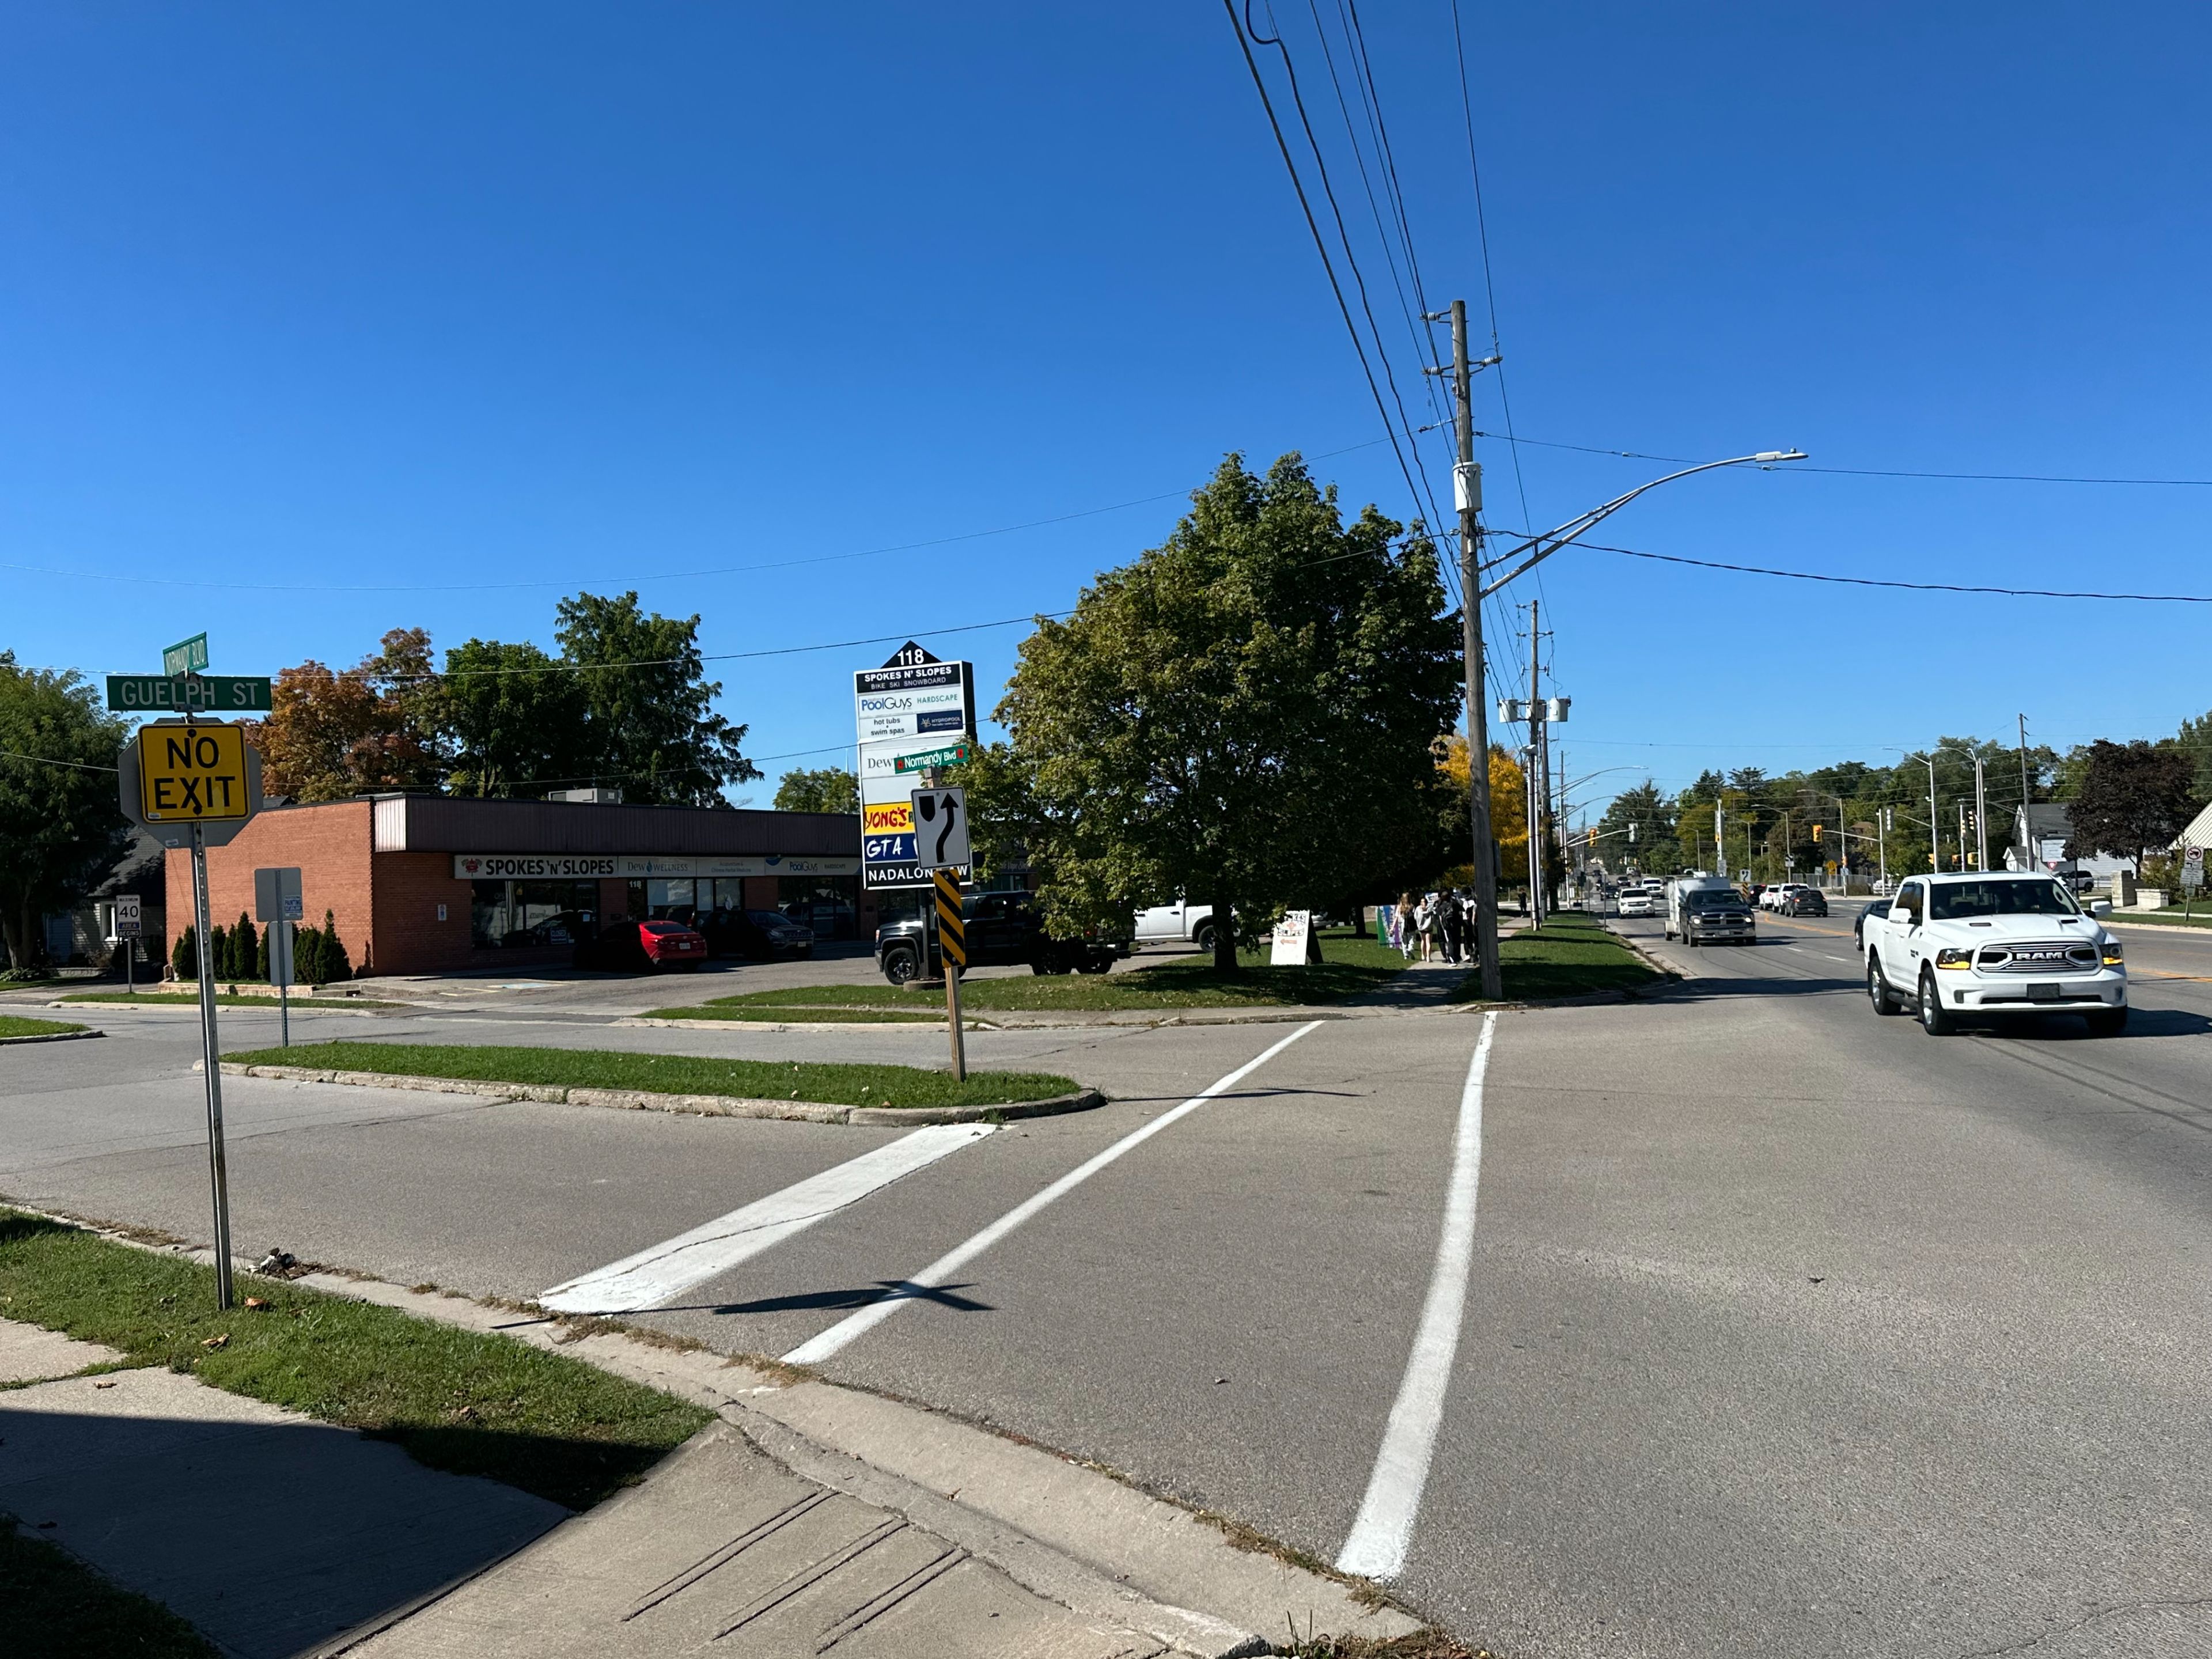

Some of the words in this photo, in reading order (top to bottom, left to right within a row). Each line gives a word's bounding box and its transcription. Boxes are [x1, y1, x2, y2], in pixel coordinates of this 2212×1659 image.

[897, 649, 924, 665] 118
[865, 672, 902, 682] SPOKES
[916, 666, 952, 677] SLOPES
[904, 677, 946, 687] SNOWBOARD
[122, 681, 215, 706] GUELPH
[232, 682, 259, 706] ST
[917, 694, 957, 703] HARDSCAPE
[889, 728, 904, 736] spas
[166, 737, 219, 770] NO
[904, 751, 942, 768] Normandy
[944, 750, 957, 762] Blvd
[868, 757, 894, 769] Dew
[154, 776, 236, 810] EXIT
[866, 836, 903, 858] GTA
[486, 859, 544, 875] SPOKES
[563, 859, 614, 874] SLOPES
[628, 862, 646, 872] Dew
[654, 863, 688, 872] WELLNESS
[868, 867, 933, 882] NADALON
[119, 906, 138, 918] 40
[2016, 952, 2063, 960] RAM
